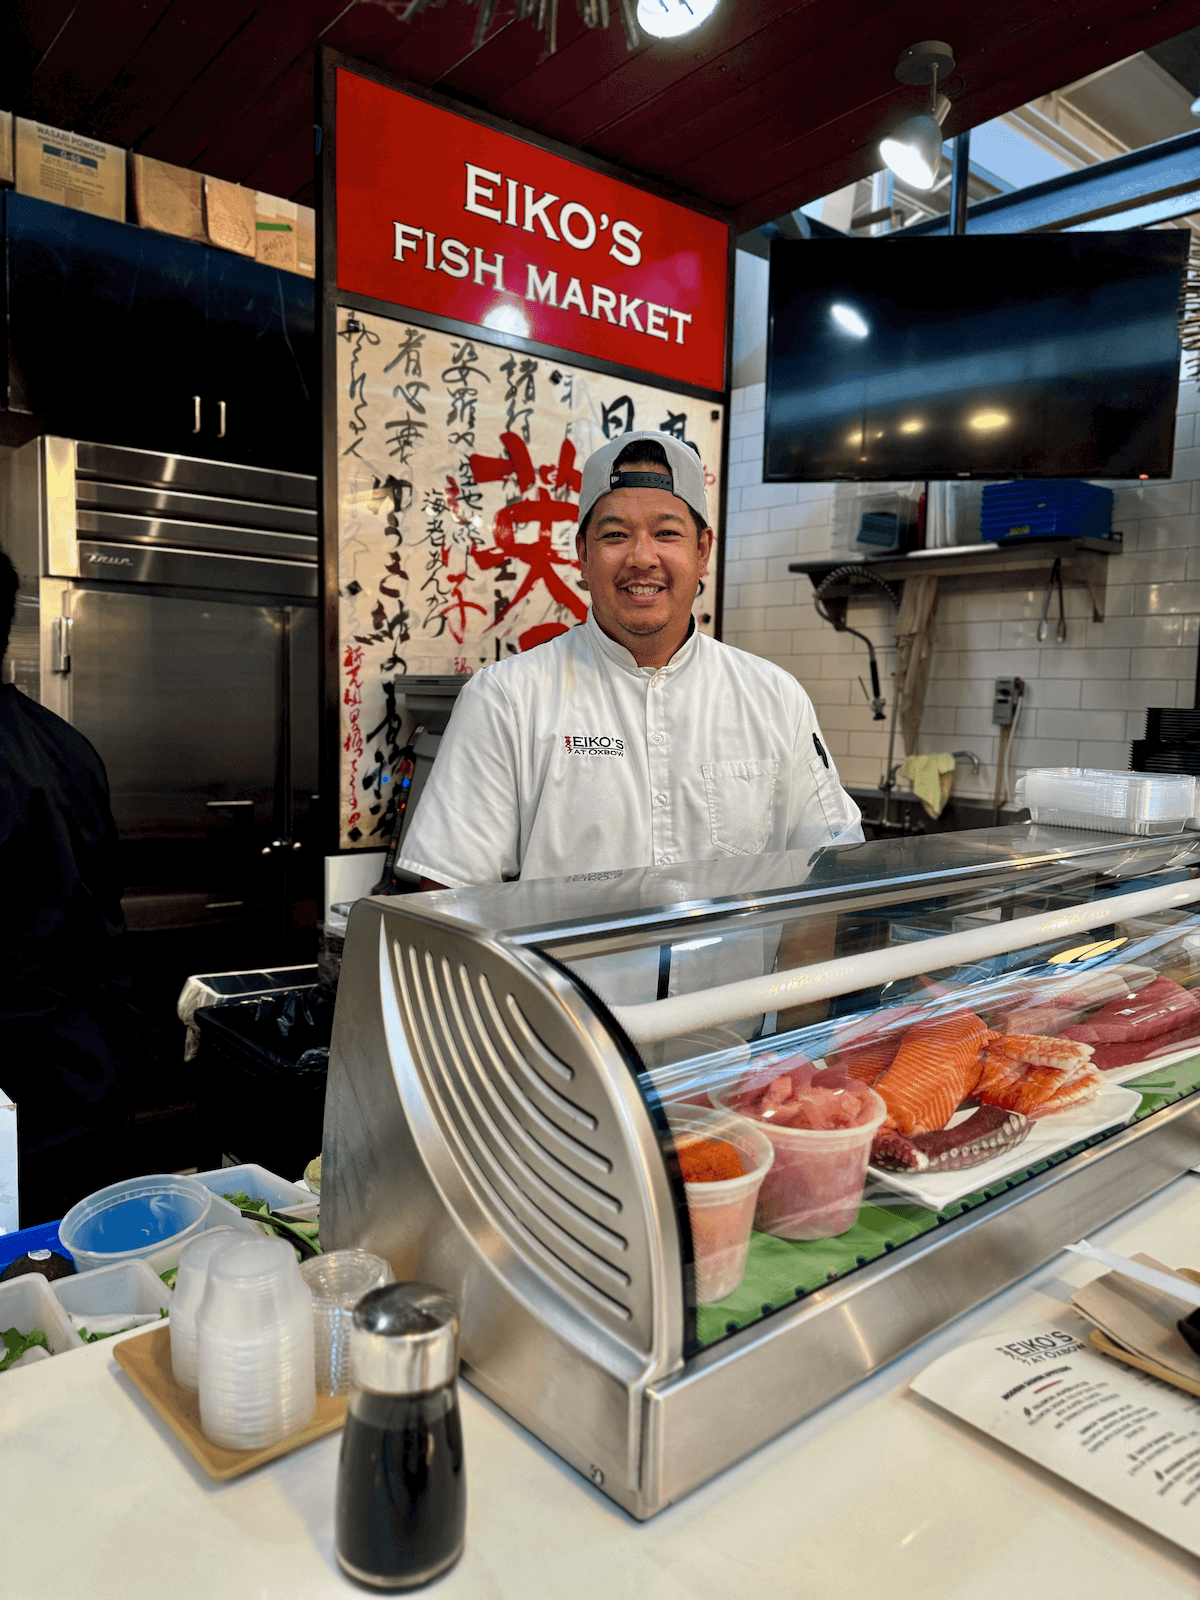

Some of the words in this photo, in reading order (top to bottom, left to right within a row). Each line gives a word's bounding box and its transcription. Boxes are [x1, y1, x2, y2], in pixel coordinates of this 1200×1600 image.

[37, 125, 70, 142] WASABI
[71, 136, 106, 153] POWDER
[464, 161, 643, 267] EIKO'S
[392, 220, 505, 292] FISH
[525, 263, 692, 345] MARKET
[573, 736, 624, 750] EIKO'S
[588, 749, 624, 757] OXBOW
[1004, 1330, 1074, 1356] EIKO'S
[1030, 1354, 1047, 1364] AT
